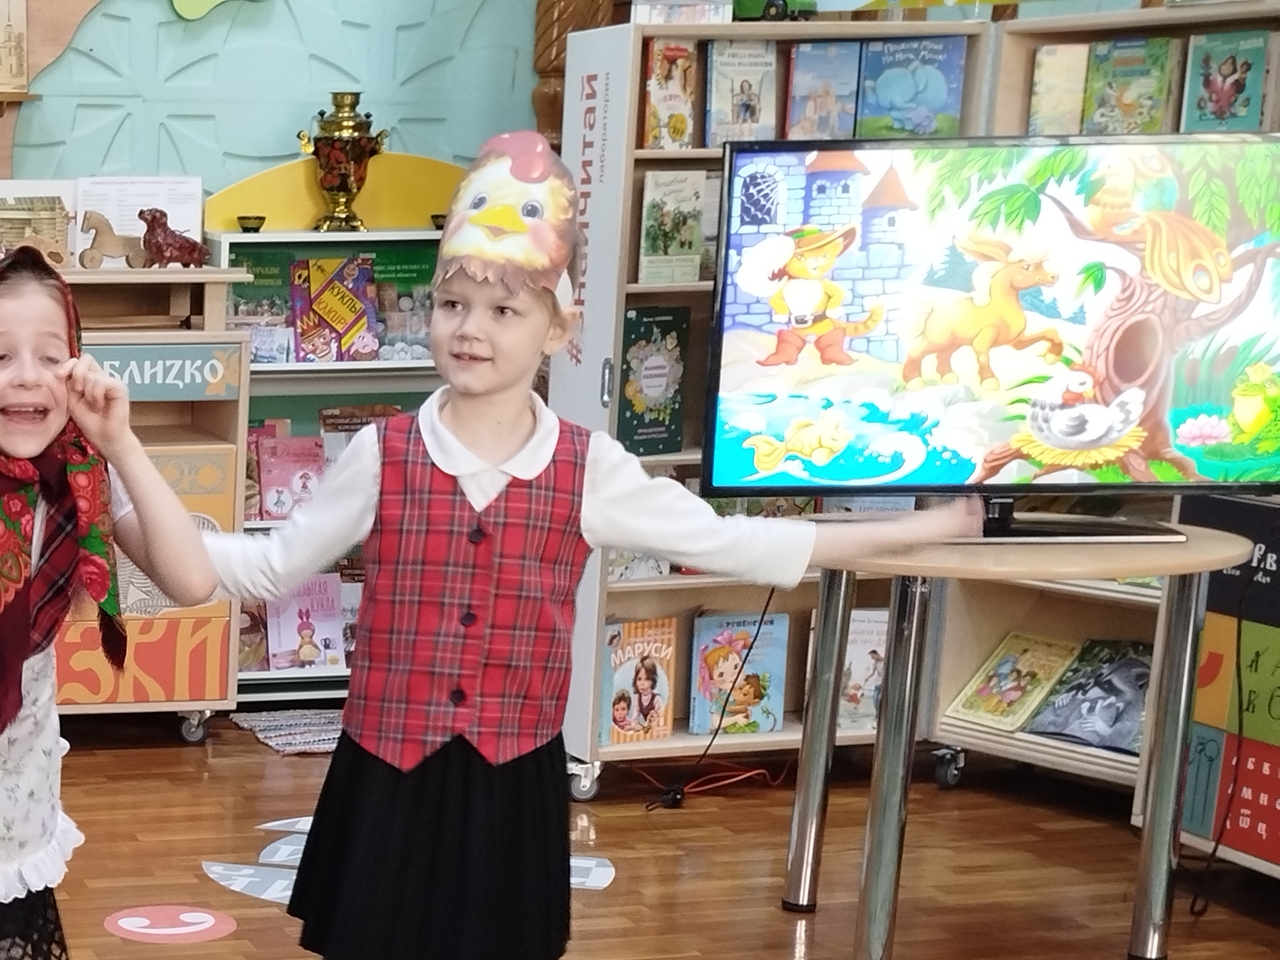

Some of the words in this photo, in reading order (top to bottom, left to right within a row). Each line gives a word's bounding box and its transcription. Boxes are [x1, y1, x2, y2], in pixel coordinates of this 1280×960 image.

[598, 72, 611, 184] лаборатория
[327, 282, 362, 317] КУКЛЫ
[611, 641, 673, 667] МАРУСИ
